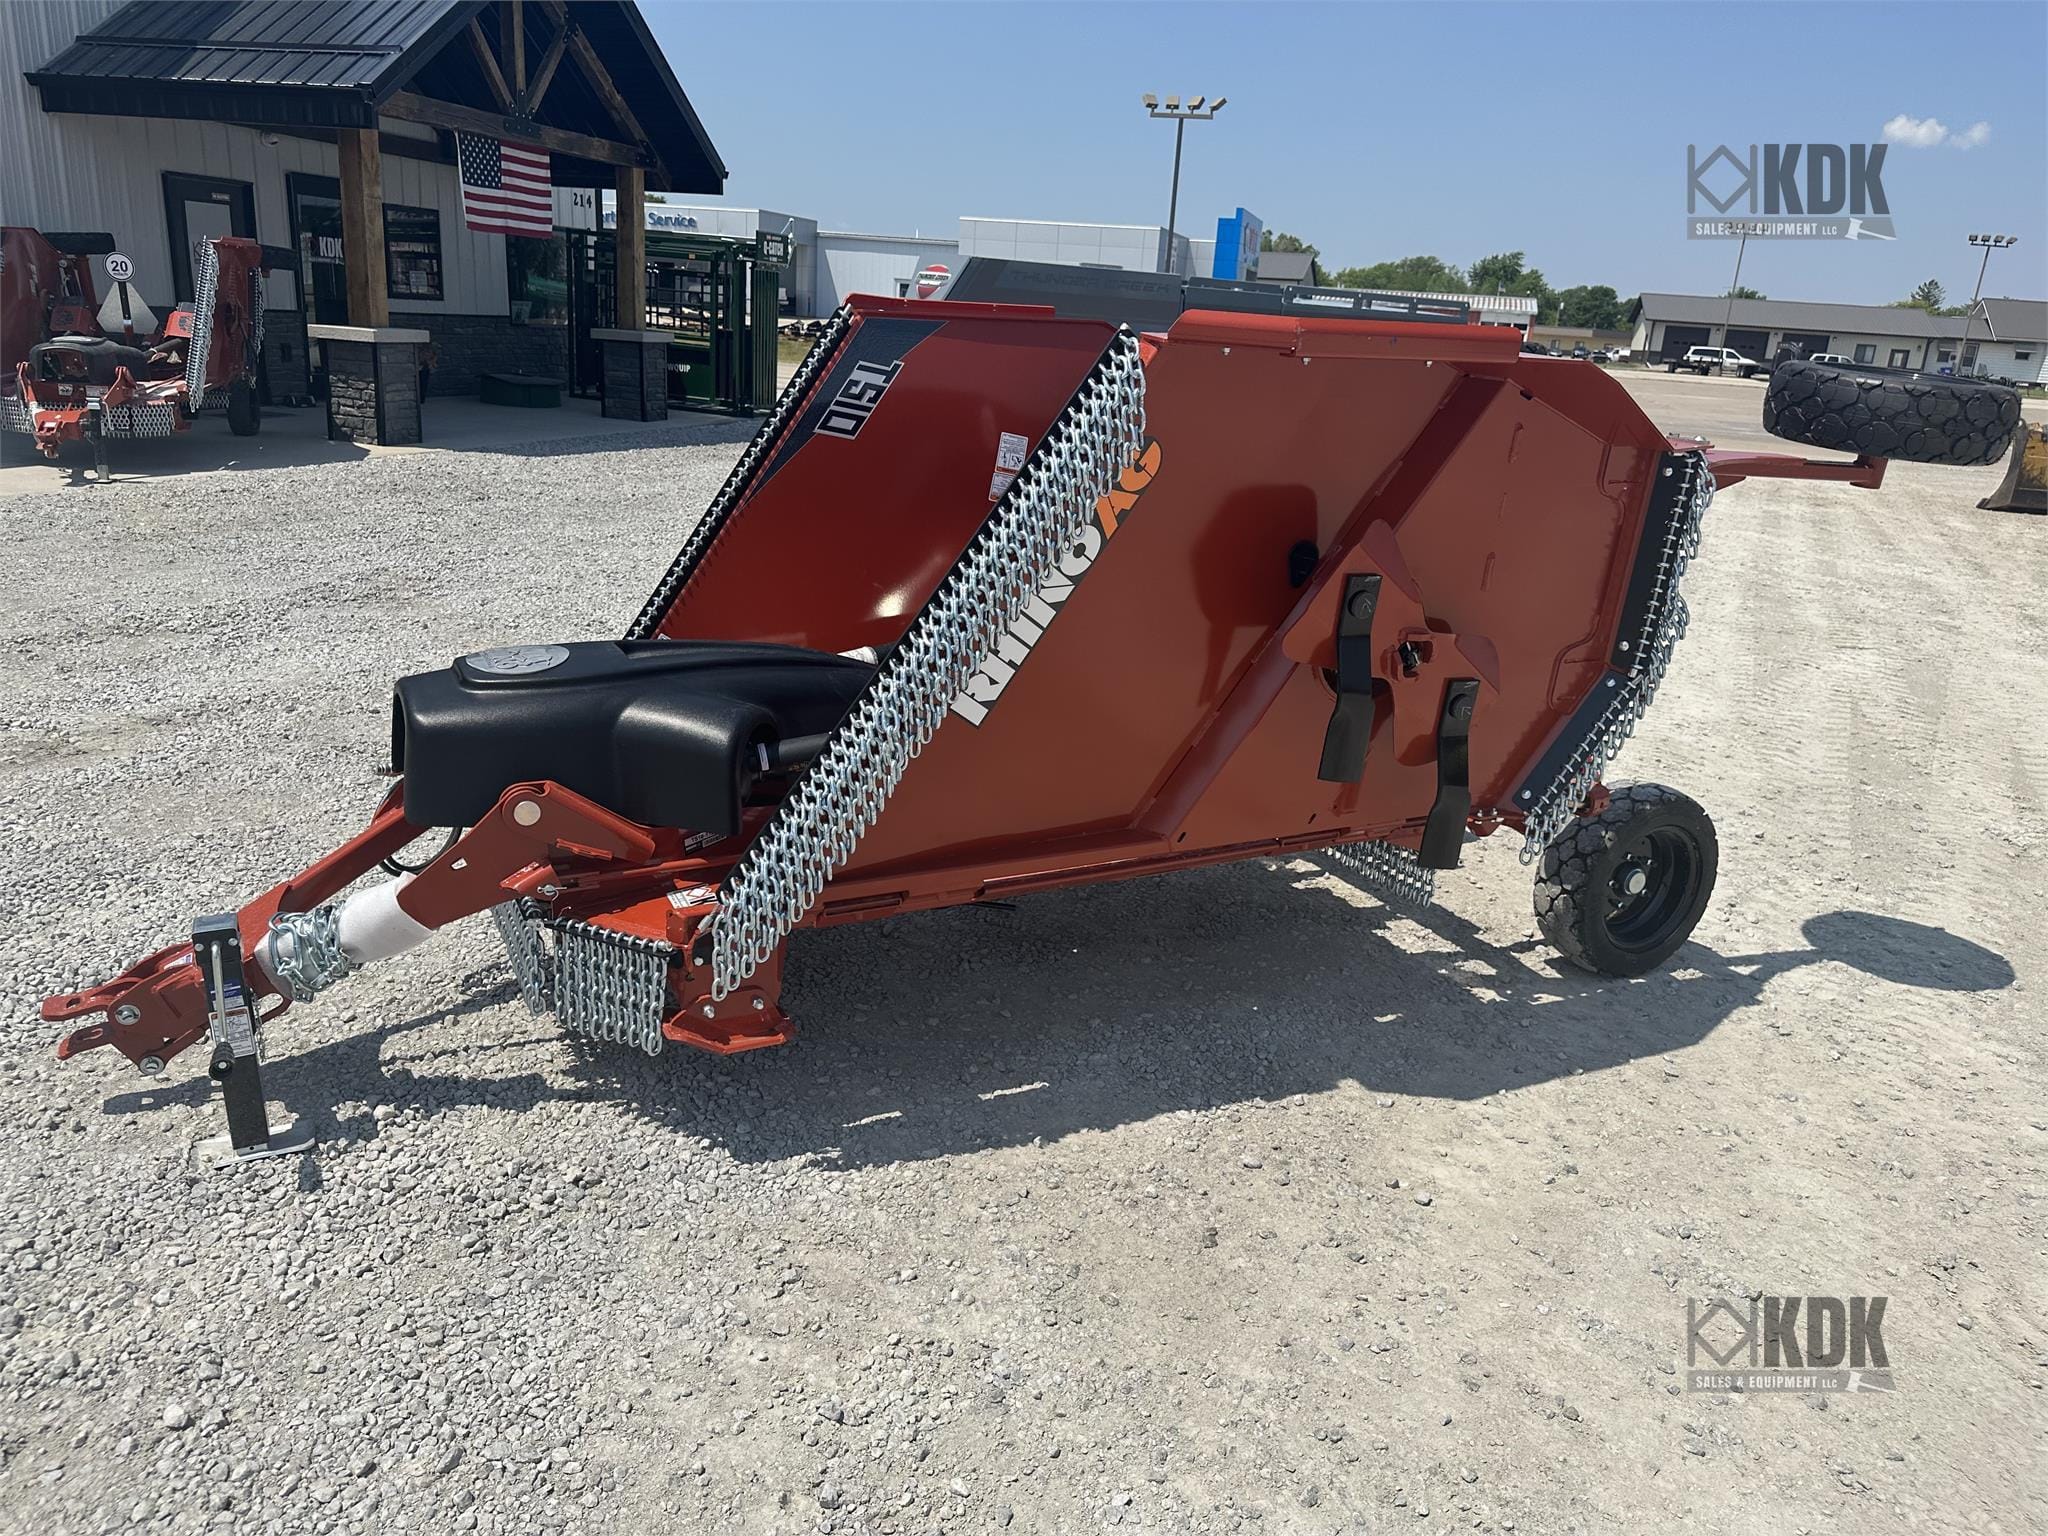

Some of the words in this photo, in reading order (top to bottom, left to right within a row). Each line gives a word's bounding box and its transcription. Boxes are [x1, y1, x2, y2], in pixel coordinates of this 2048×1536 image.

[573, 192, 592, 208] 214
[648, 212, 698, 228] Service
[319, 236, 343, 259] KDK
[110, 260, 128, 272] 20
